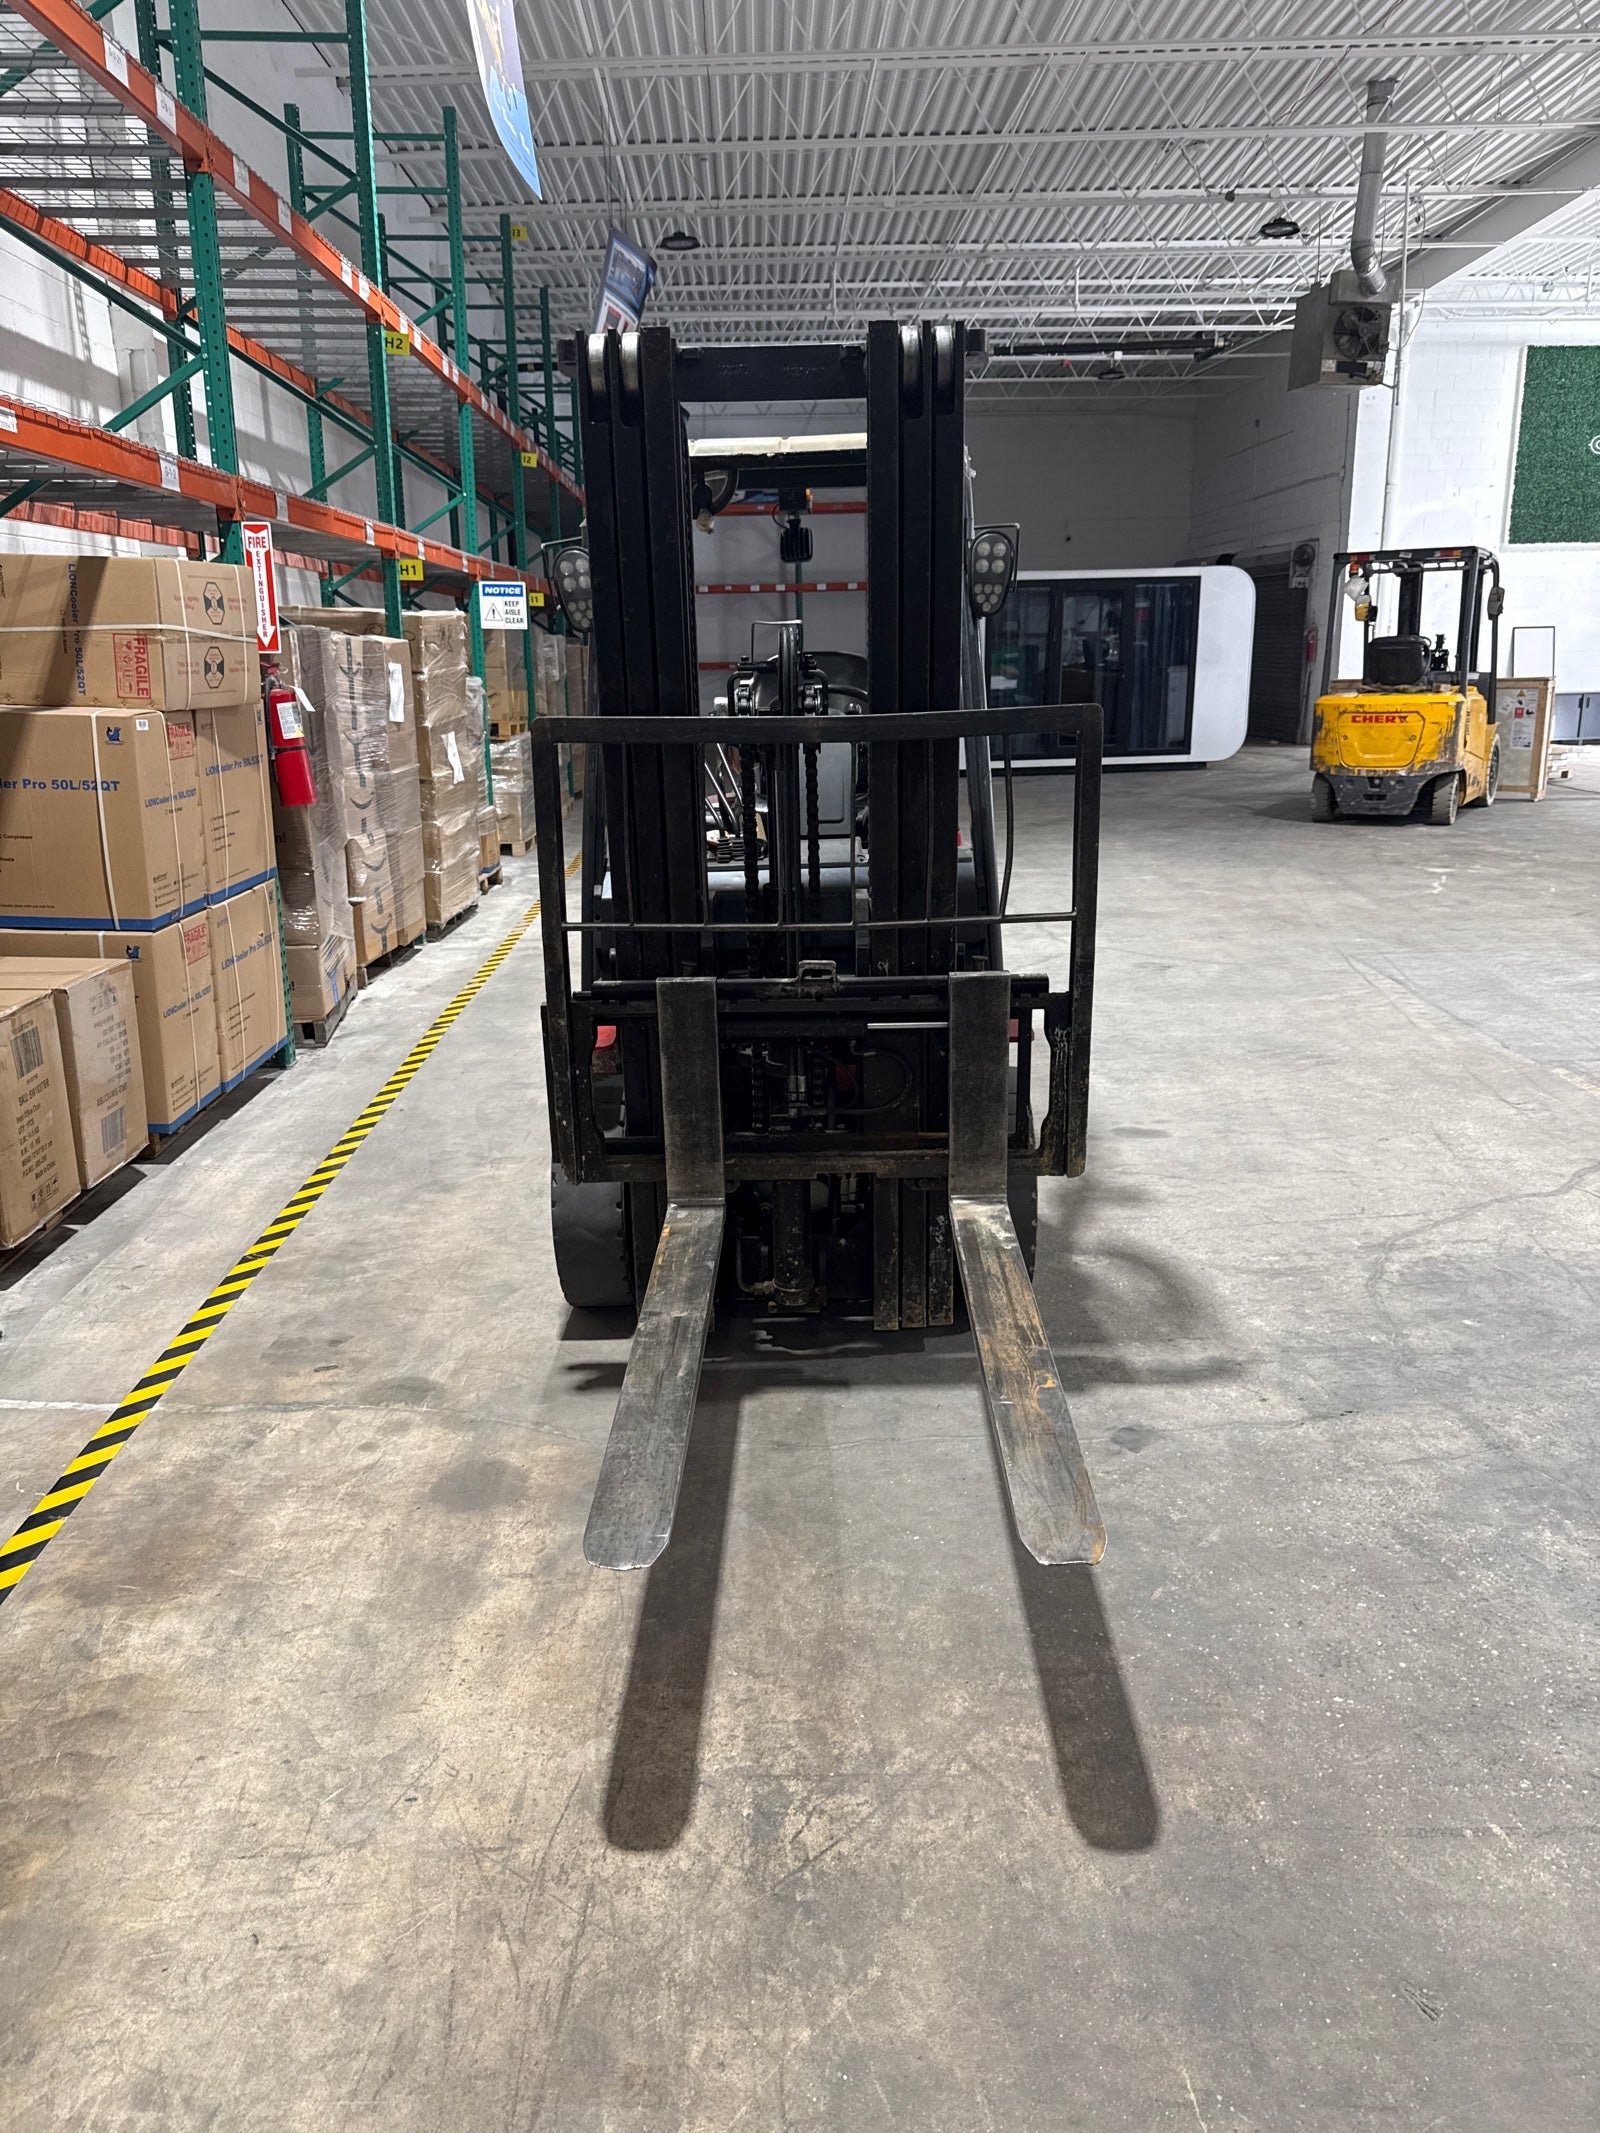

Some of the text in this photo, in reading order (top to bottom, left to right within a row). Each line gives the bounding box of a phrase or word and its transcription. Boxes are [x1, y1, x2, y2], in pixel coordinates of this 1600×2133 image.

[385, 337, 403, 350] H2
[247, 536, 267, 549] FIRE
[400, 564, 417, 576] H1
[256, 550, 268, 638] EXTINGUISHER
[484, 586, 522, 595] NOTICE
[504, 608, 521, 616] AISLE
[504, 616, 524, 625] CLEAR
[74, 647, 86, 695] 50L/52QT
[133, 636, 149, 697] FRAGILE
[22, 779, 47, 789] Pro
[51, 779, 120, 791] 50L/52QT
